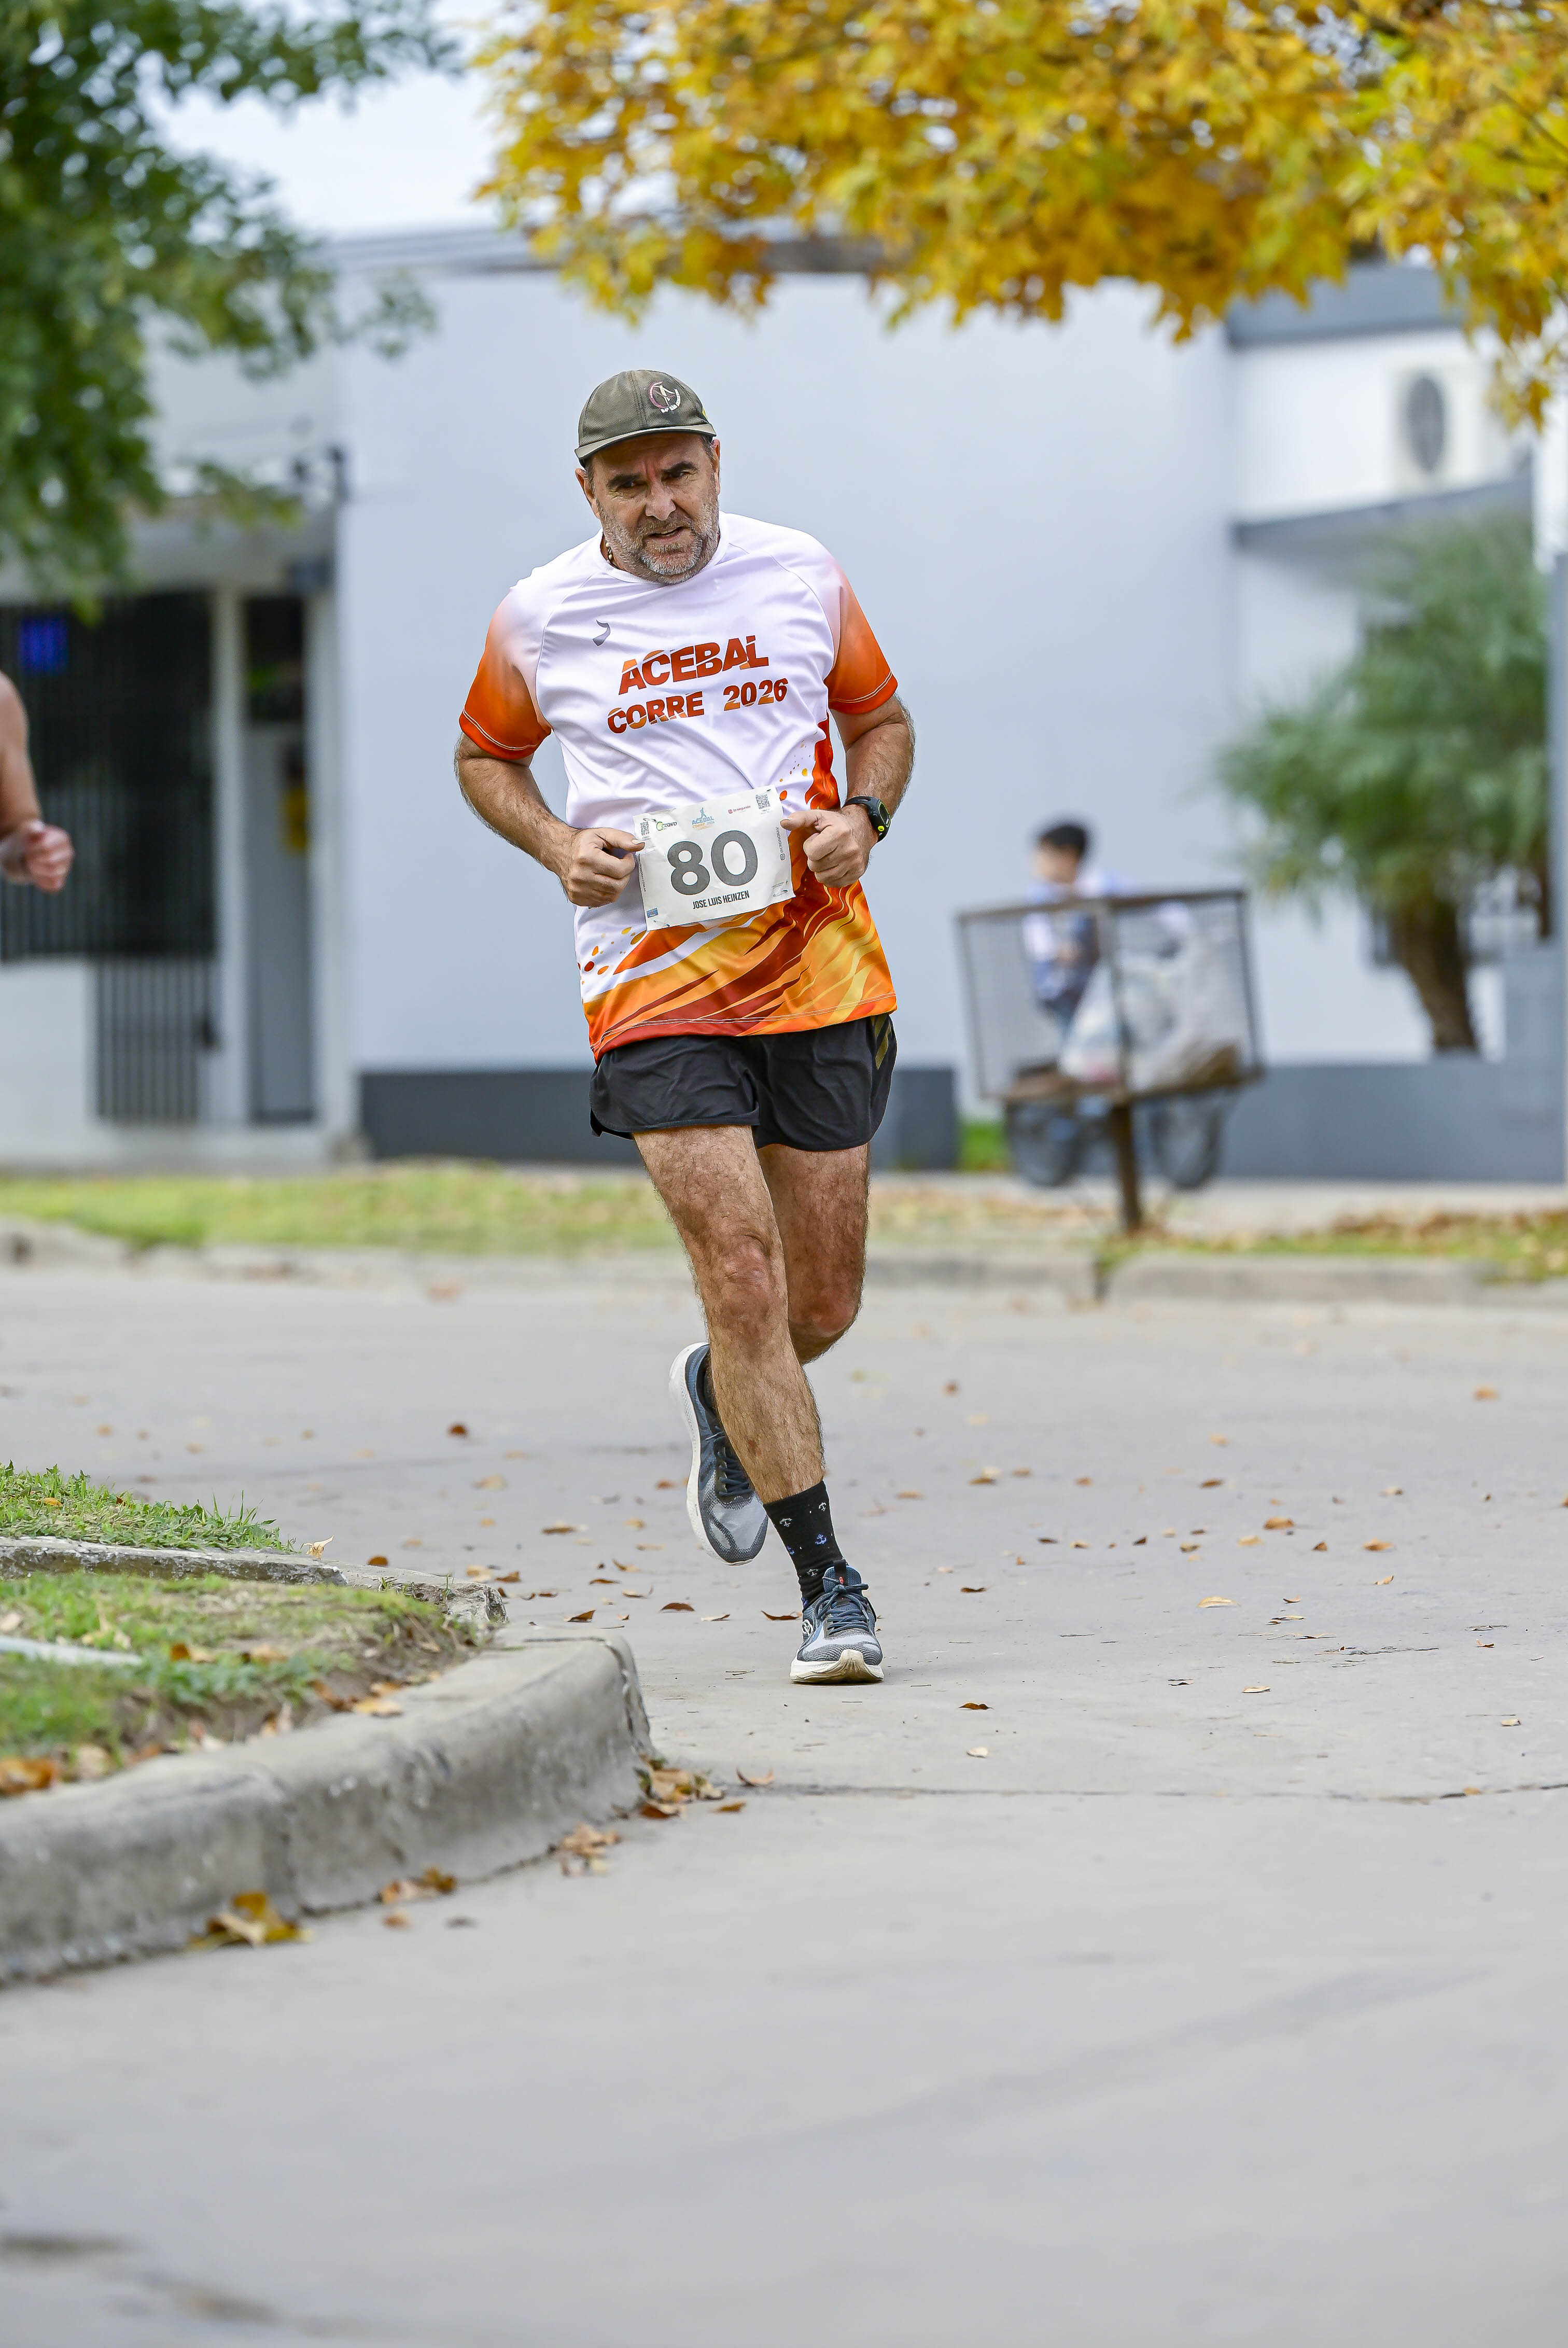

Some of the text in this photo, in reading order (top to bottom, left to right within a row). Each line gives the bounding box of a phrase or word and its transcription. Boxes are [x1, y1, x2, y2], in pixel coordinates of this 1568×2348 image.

[619, 635, 769, 695] ACEBAL
[607, 678, 789, 734] CORRE 2026
[667, 830, 758, 895] 80
[693, 890, 750, 909] JOSE LUIS HEINZEN
